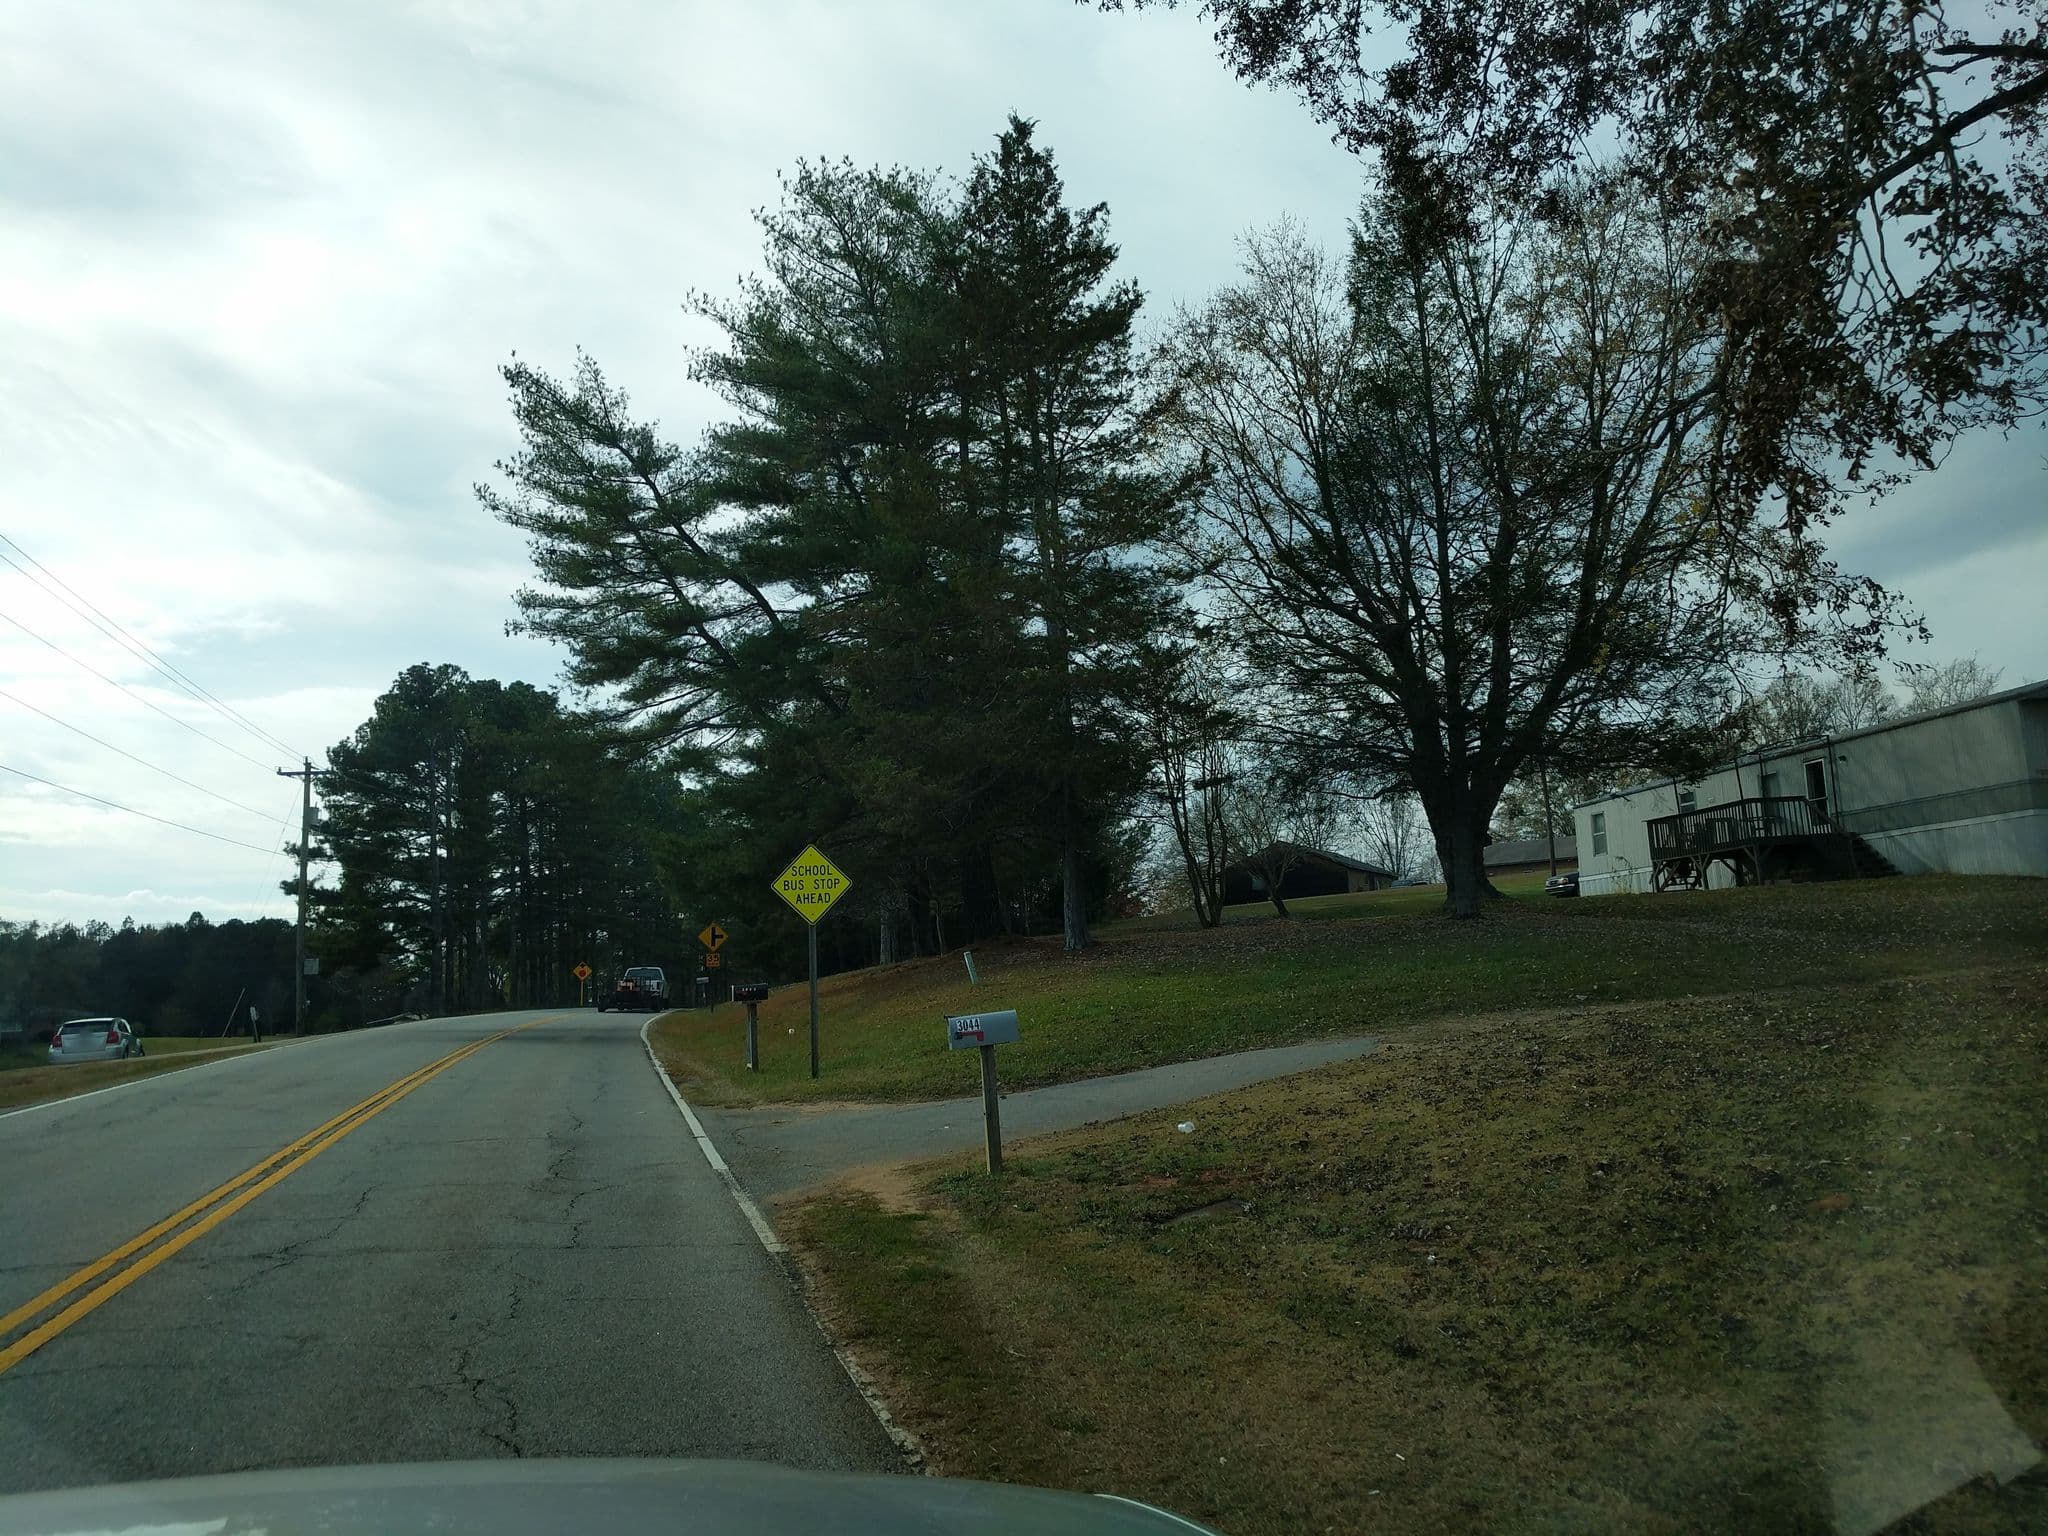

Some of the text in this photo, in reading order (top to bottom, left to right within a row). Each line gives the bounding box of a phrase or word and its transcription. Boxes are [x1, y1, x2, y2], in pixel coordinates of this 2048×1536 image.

[791, 865, 833, 876] SCHOOL
[783, 878, 840, 891] BUS STOP
[795, 892, 831, 904] AHEAD
[957, 1018, 980, 1031] 3044
